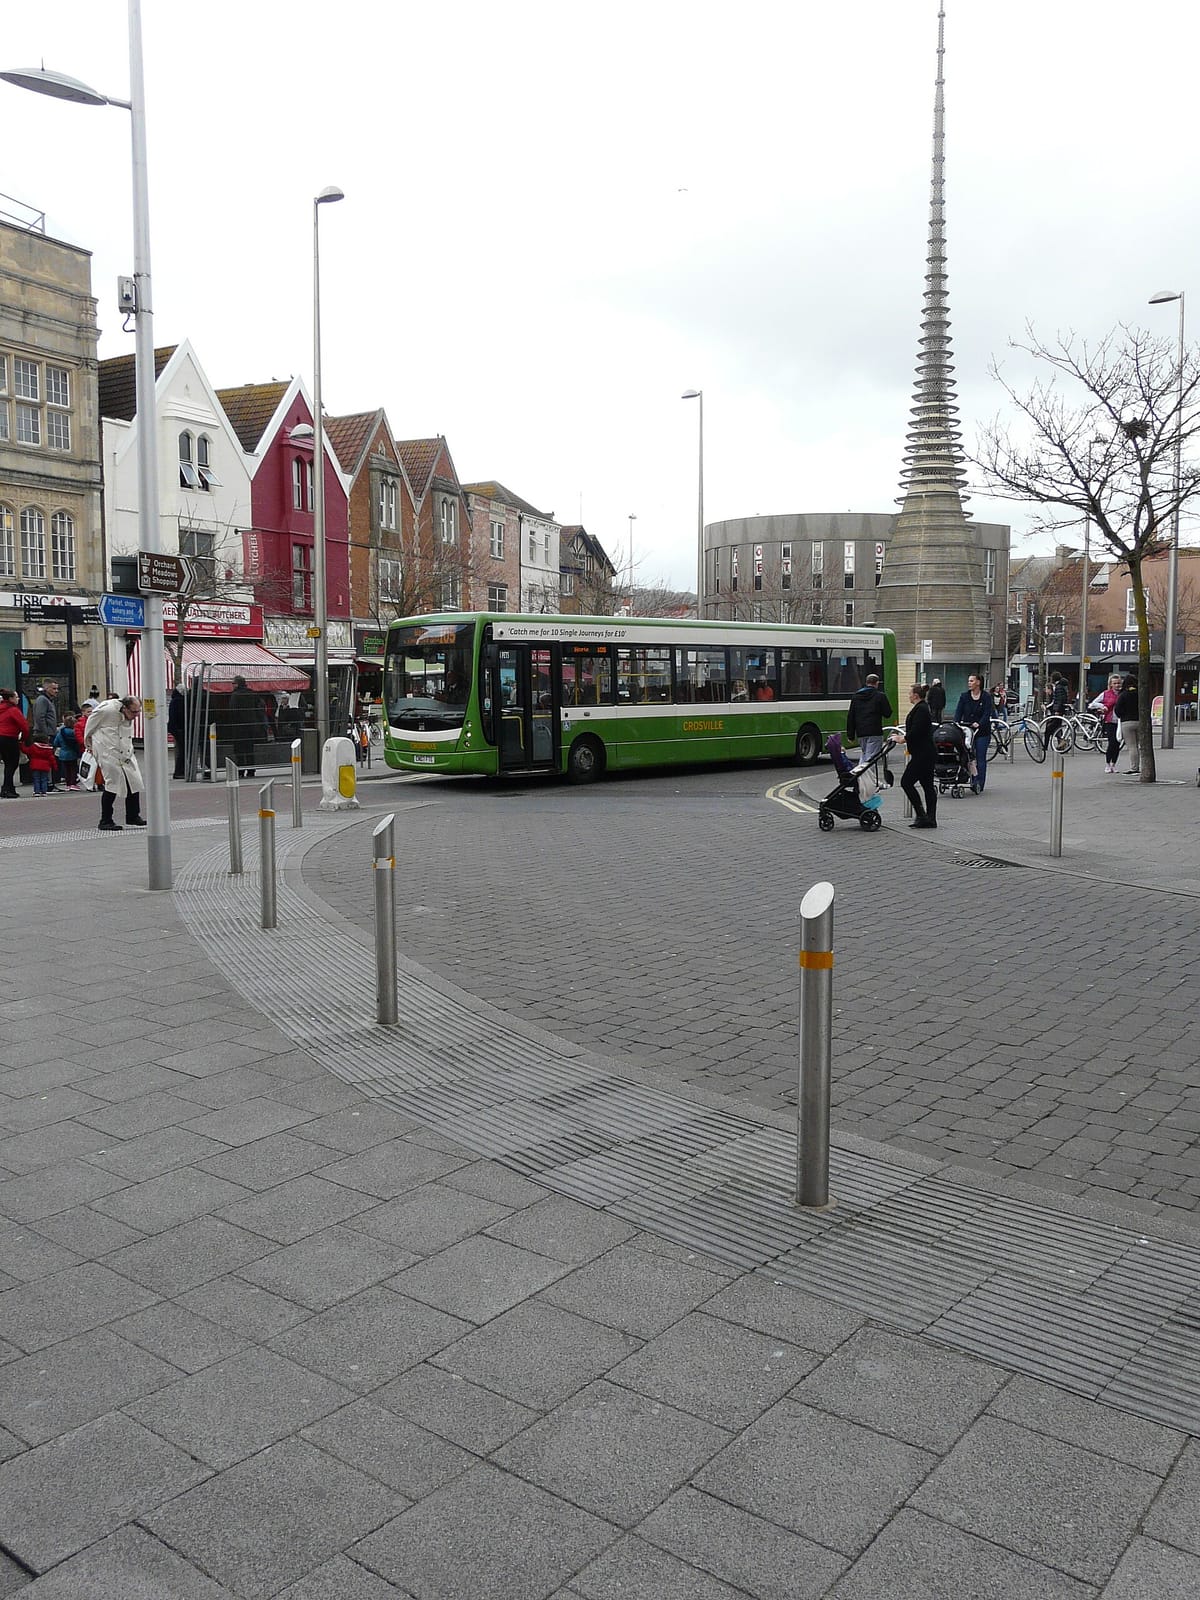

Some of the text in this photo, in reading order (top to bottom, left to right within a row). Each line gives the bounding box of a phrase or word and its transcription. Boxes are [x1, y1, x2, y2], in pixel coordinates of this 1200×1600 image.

[153, 560, 177, 570] Orchard
[152, 567, 178, 579] Meadows
[152, 576, 178, 588] Shopping
[13, 594, 48, 606] HSBC
[560, 628, 578, 637] Single
[579, 630, 604, 638] Journeys
[604, 630, 614, 638] for
[1100, 639, 1152, 652] CANTE
[682, 719, 725, 731] CROSVILLE
